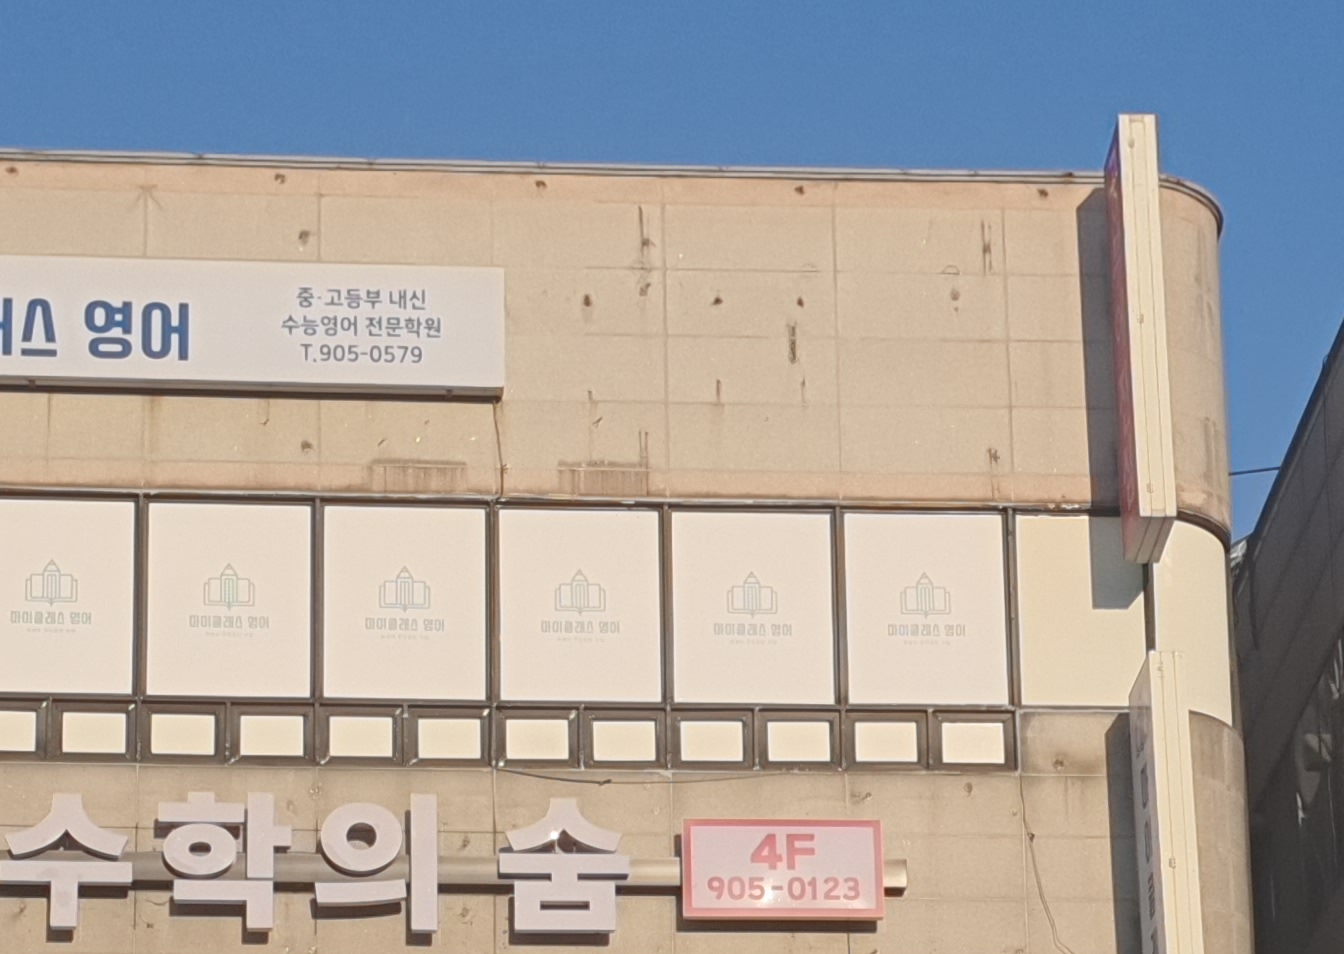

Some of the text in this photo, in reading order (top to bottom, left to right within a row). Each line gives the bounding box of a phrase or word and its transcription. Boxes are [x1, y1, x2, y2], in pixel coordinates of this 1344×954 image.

[295, 287, 427, 311] 중·고등부 내신
[83, 298, 190, 361] 영어
[280, 315, 443, 339] 수능영어 전문학원
[300, 343, 424, 364] T.905-0579
[748, 832, 816, 871] 4F
[498, 797, 630, 934] 숨
[706, 875, 861, 902] 905-0123
